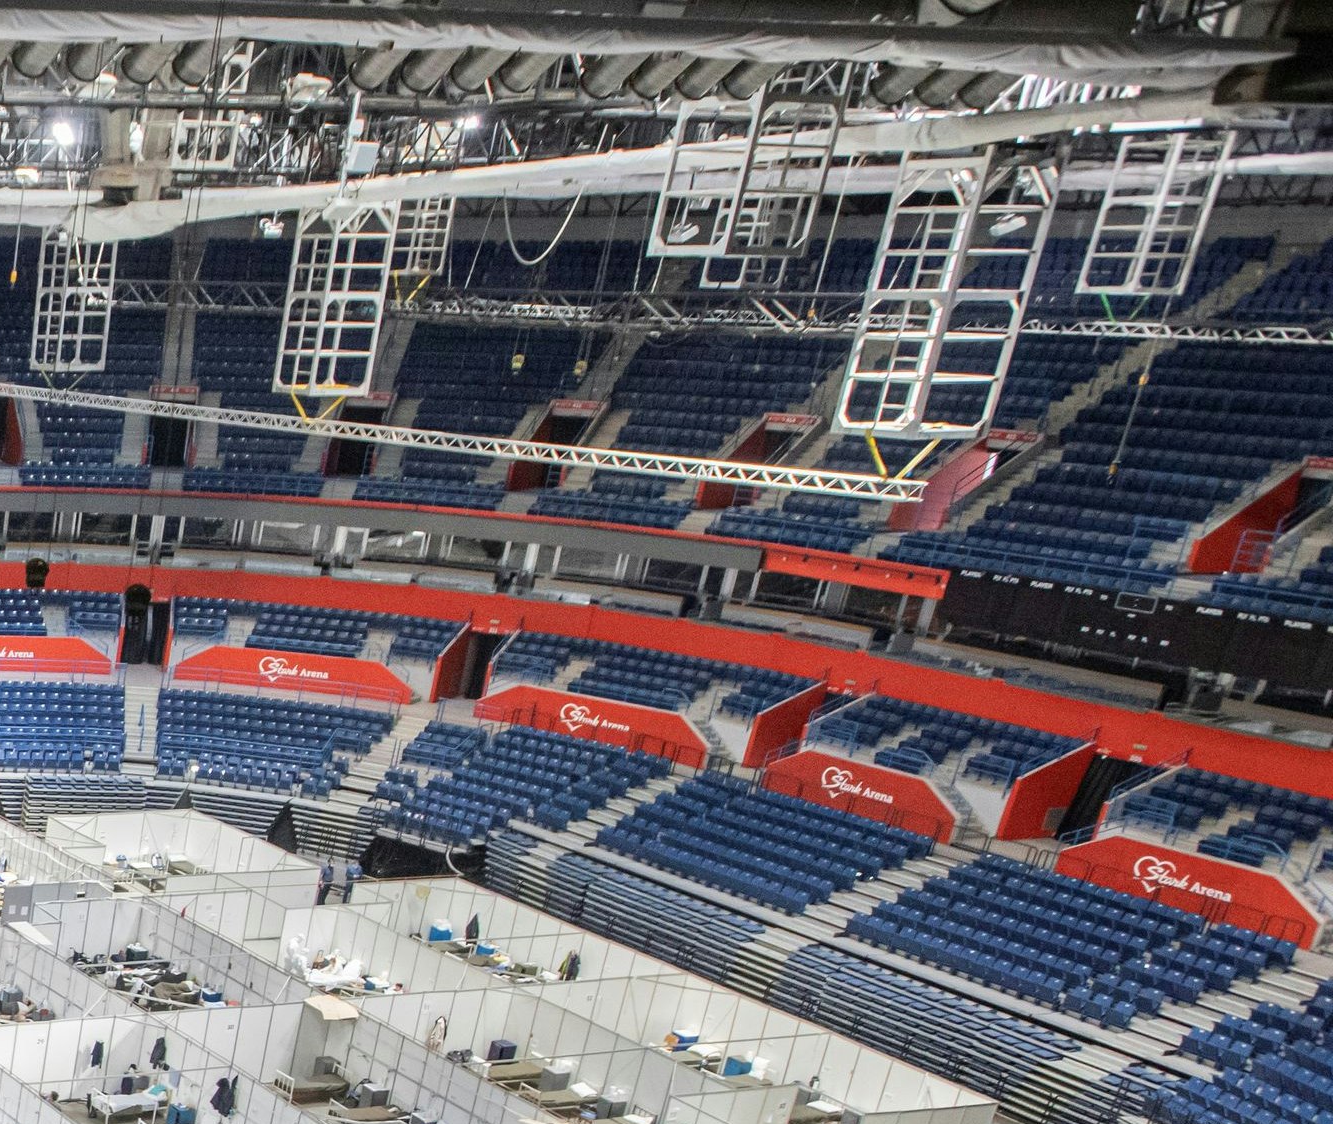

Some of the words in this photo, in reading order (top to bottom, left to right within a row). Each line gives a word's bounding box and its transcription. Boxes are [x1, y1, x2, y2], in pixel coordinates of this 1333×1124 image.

[7, 649, 35, 659] Arena
[299, 668, 330, 680] Arena
[862, 787, 895, 805] Arena
[1188, 881, 1233, 903] Arena
